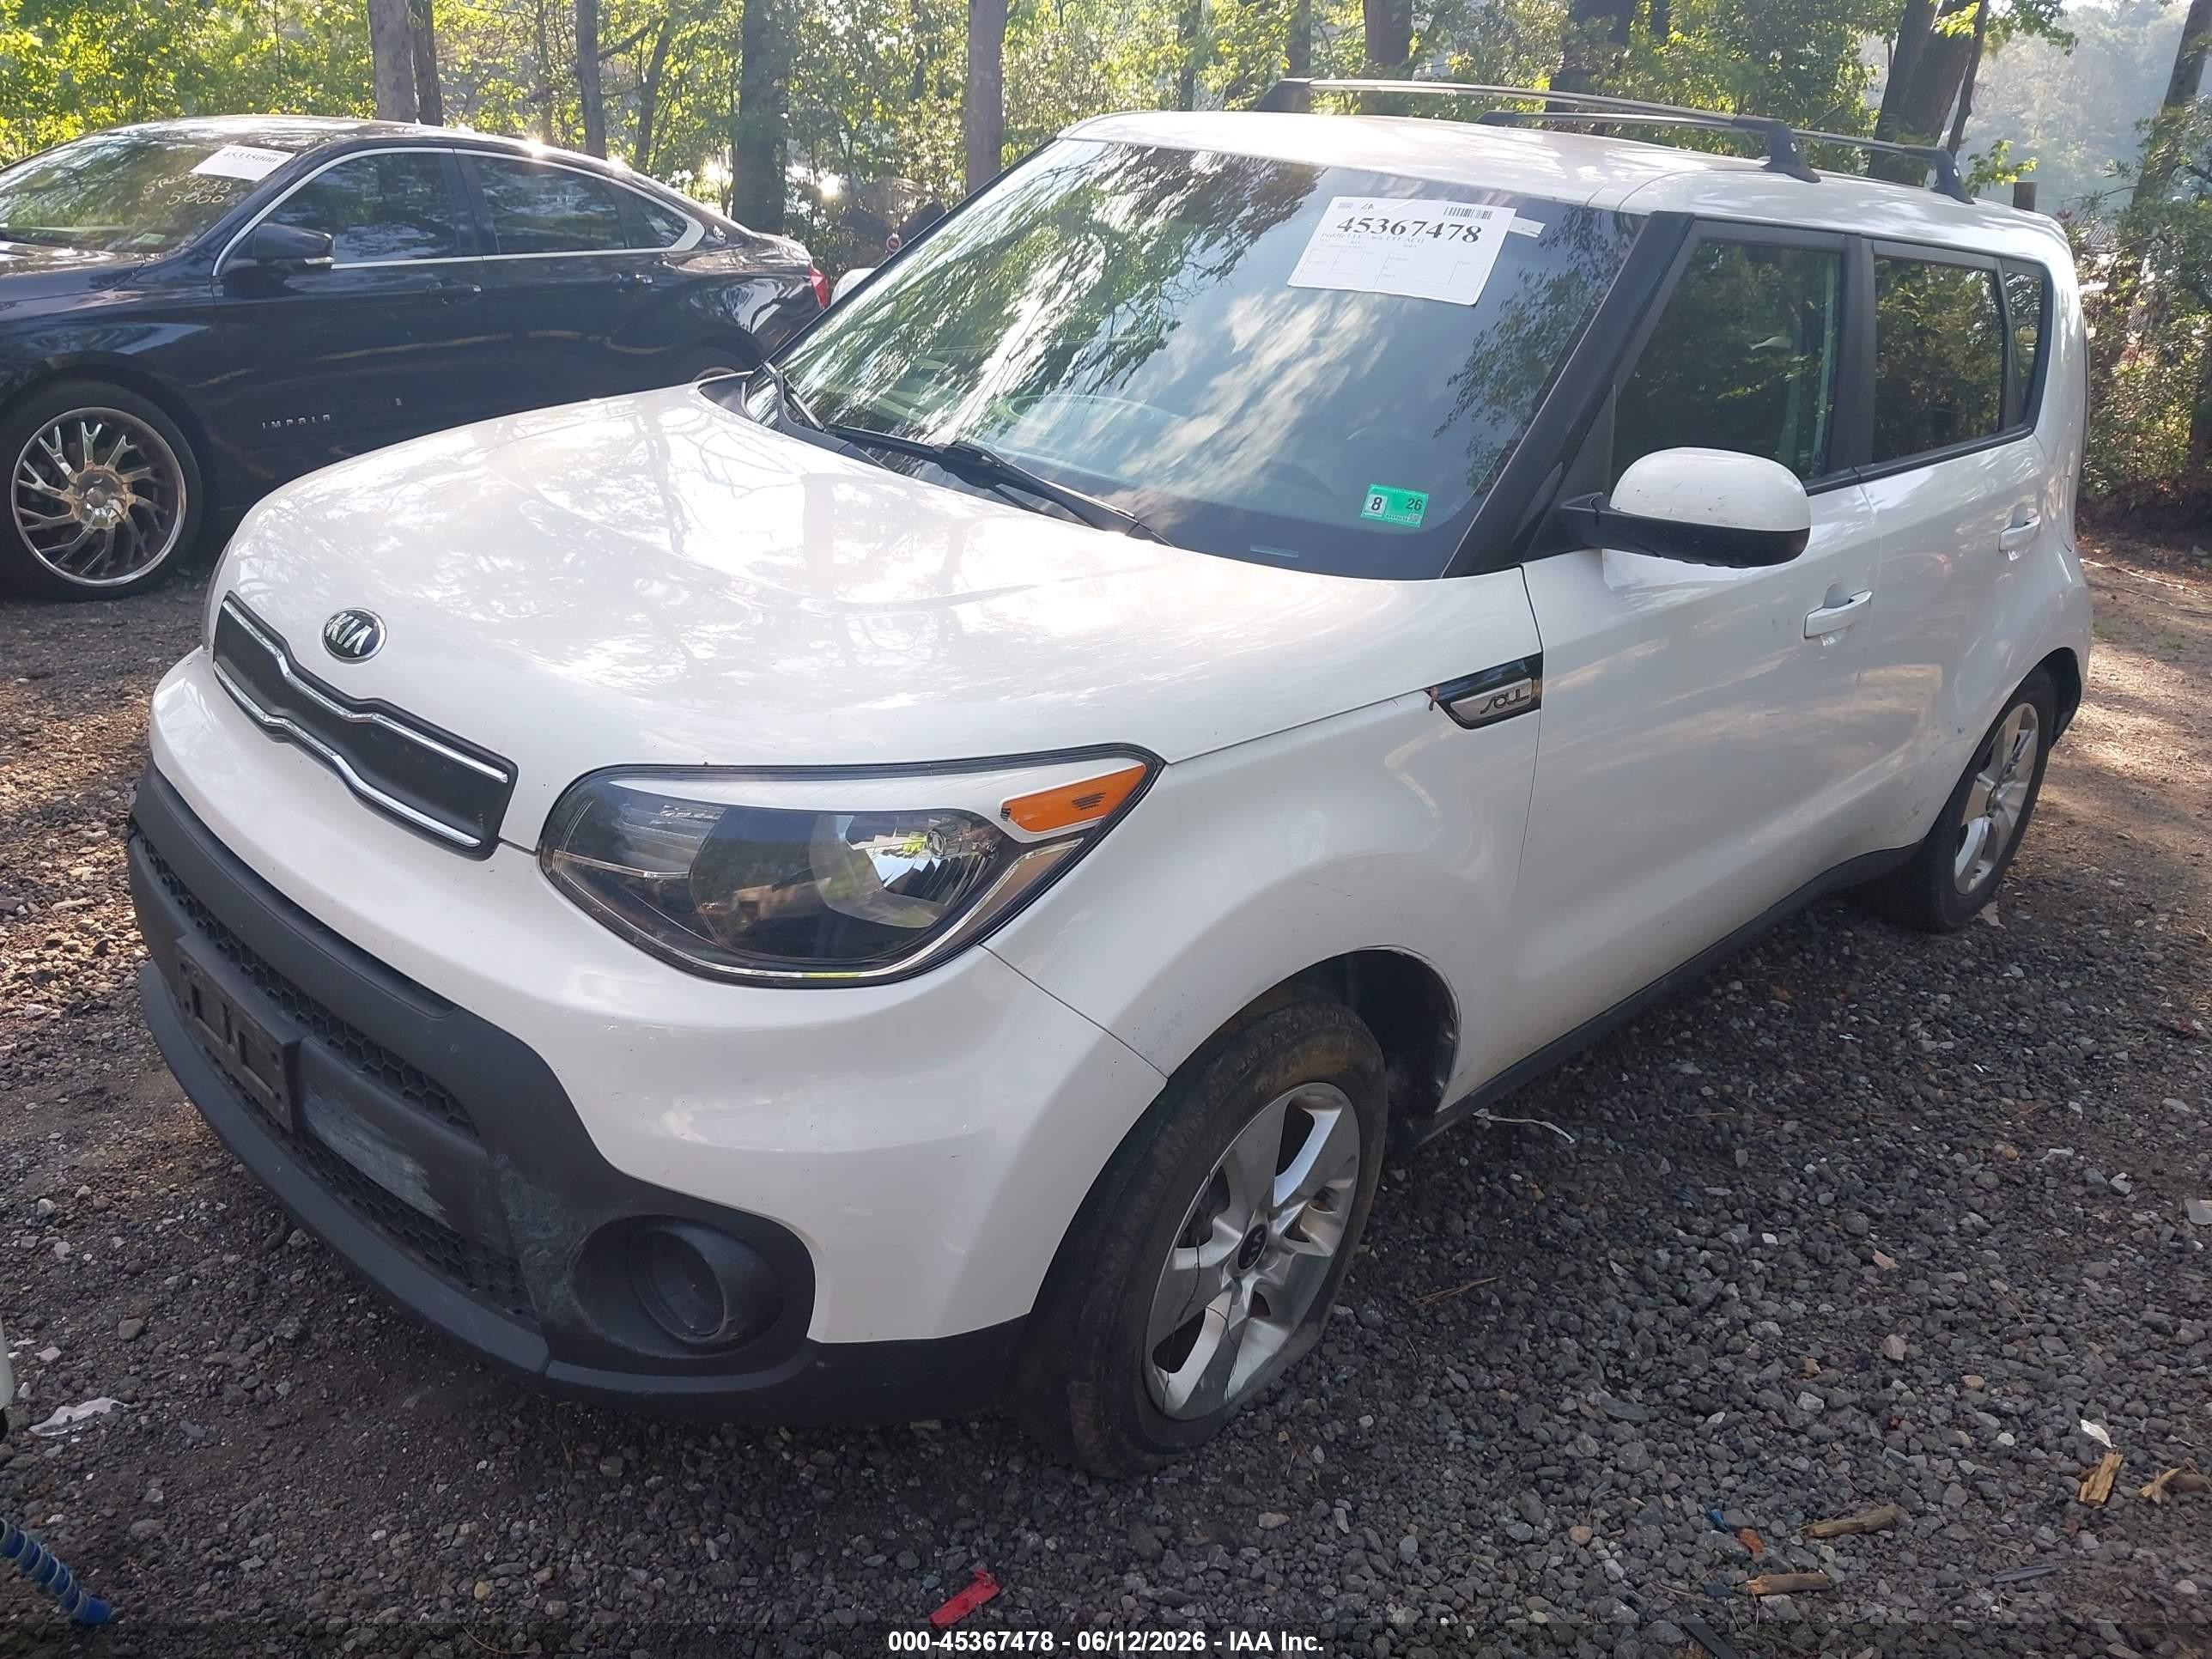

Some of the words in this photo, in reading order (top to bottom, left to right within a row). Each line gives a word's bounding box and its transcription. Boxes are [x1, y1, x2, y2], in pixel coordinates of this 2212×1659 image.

[1336, 216, 1483, 243] 45367478
[262, 413, 331, 430] IMPALA
[1370, 496, 1383, 511] 8
[1406, 497, 1423, 512] 26
[1480, 688, 1531, 714] SOUL
